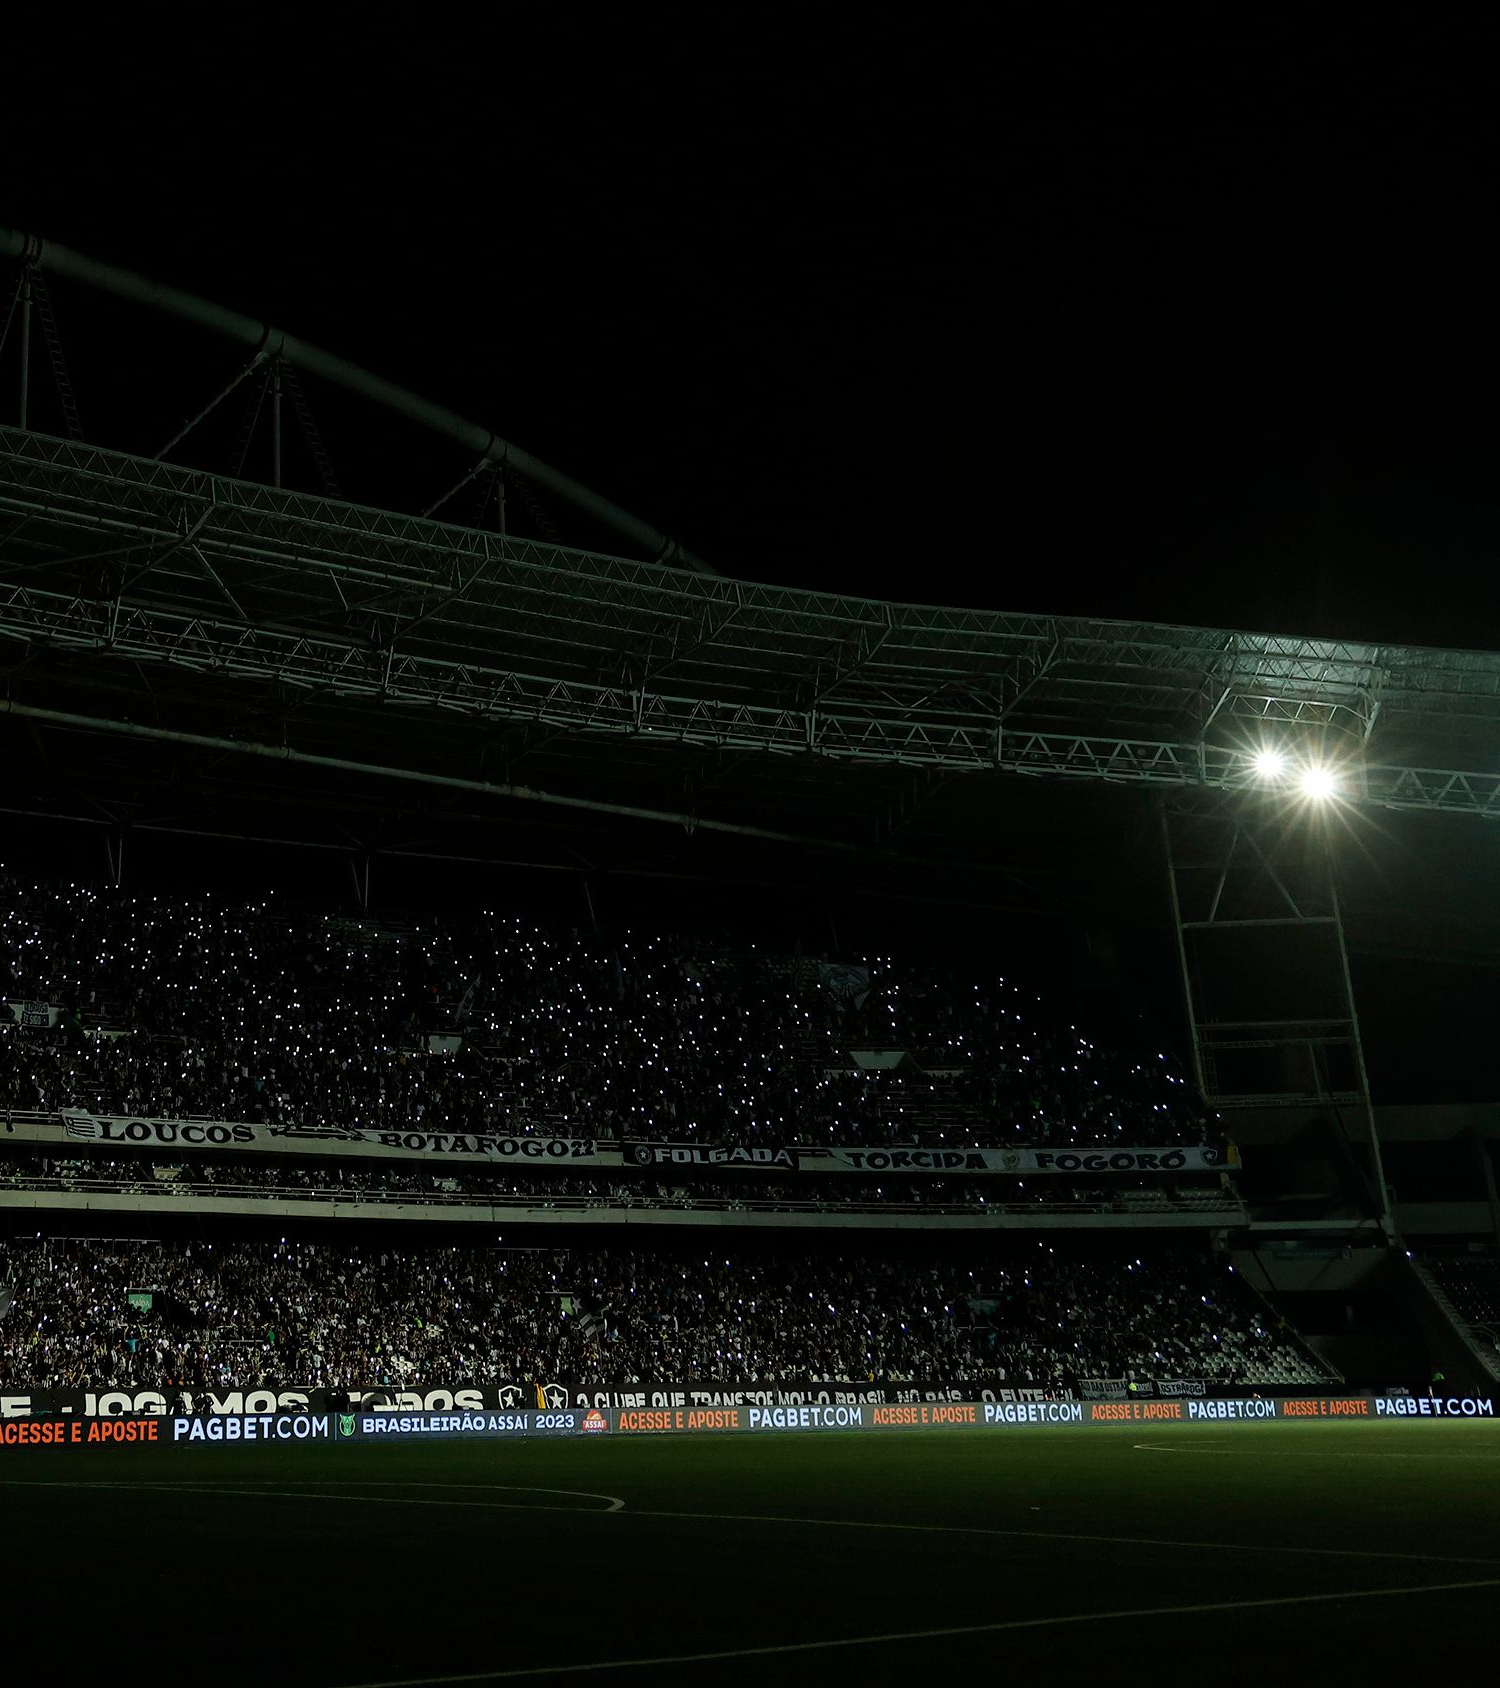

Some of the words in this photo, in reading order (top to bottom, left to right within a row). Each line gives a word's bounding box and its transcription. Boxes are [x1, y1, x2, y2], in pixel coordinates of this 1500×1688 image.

[97, 1121, 256, 1143] LOUCOS
[654, 1148, 794, 1166] FOLGADA
[846, 1150, 989, 1169] TORCIDA
[1034, 1149, 1186, 1171] FOGORÓ
[872, 1407, 918, 1425] ACESSE
[921, 1407, 929, 1424] E
[932, 1406, 976, 1424] APOSTE
[984, 1404, 1083, 1423] PAGBET.COM
[1091, 1403, 1131, 1420] ACESSE
[1133, 1403, 1141, 1420] E
[1143, 1403, 1182, 1419] APOSTE
[1188, 1401, 1276, 1419] PAGBET.COM
[1283, 1400, 1318, 1416] ACESSE
[1320, 1399, 1327, 1416] E
[1329, 1399, 1368, 1416] APOSTE
[1375, 1397, 1494, 1416] PAGBET.COM
[362, 1412, 486, 1433] BRASILEIRÃO
[488, 1413, 528, 1430] ASSAÍ
[535, 1414, 575, 1429] 2023
[618, 1411, 671, 1430] ACESSE
[675, 1411, 684, 1429] E
[688, 1410, 740, 1429] APOSTE
[749, 1406, 863, 1428] PAGBET.COM
[70, 1421, 82, 1443] E
[86, 1420, 159, 1442] APOSTE
[173, 1416, 329, 1441] PAGBET.COM
